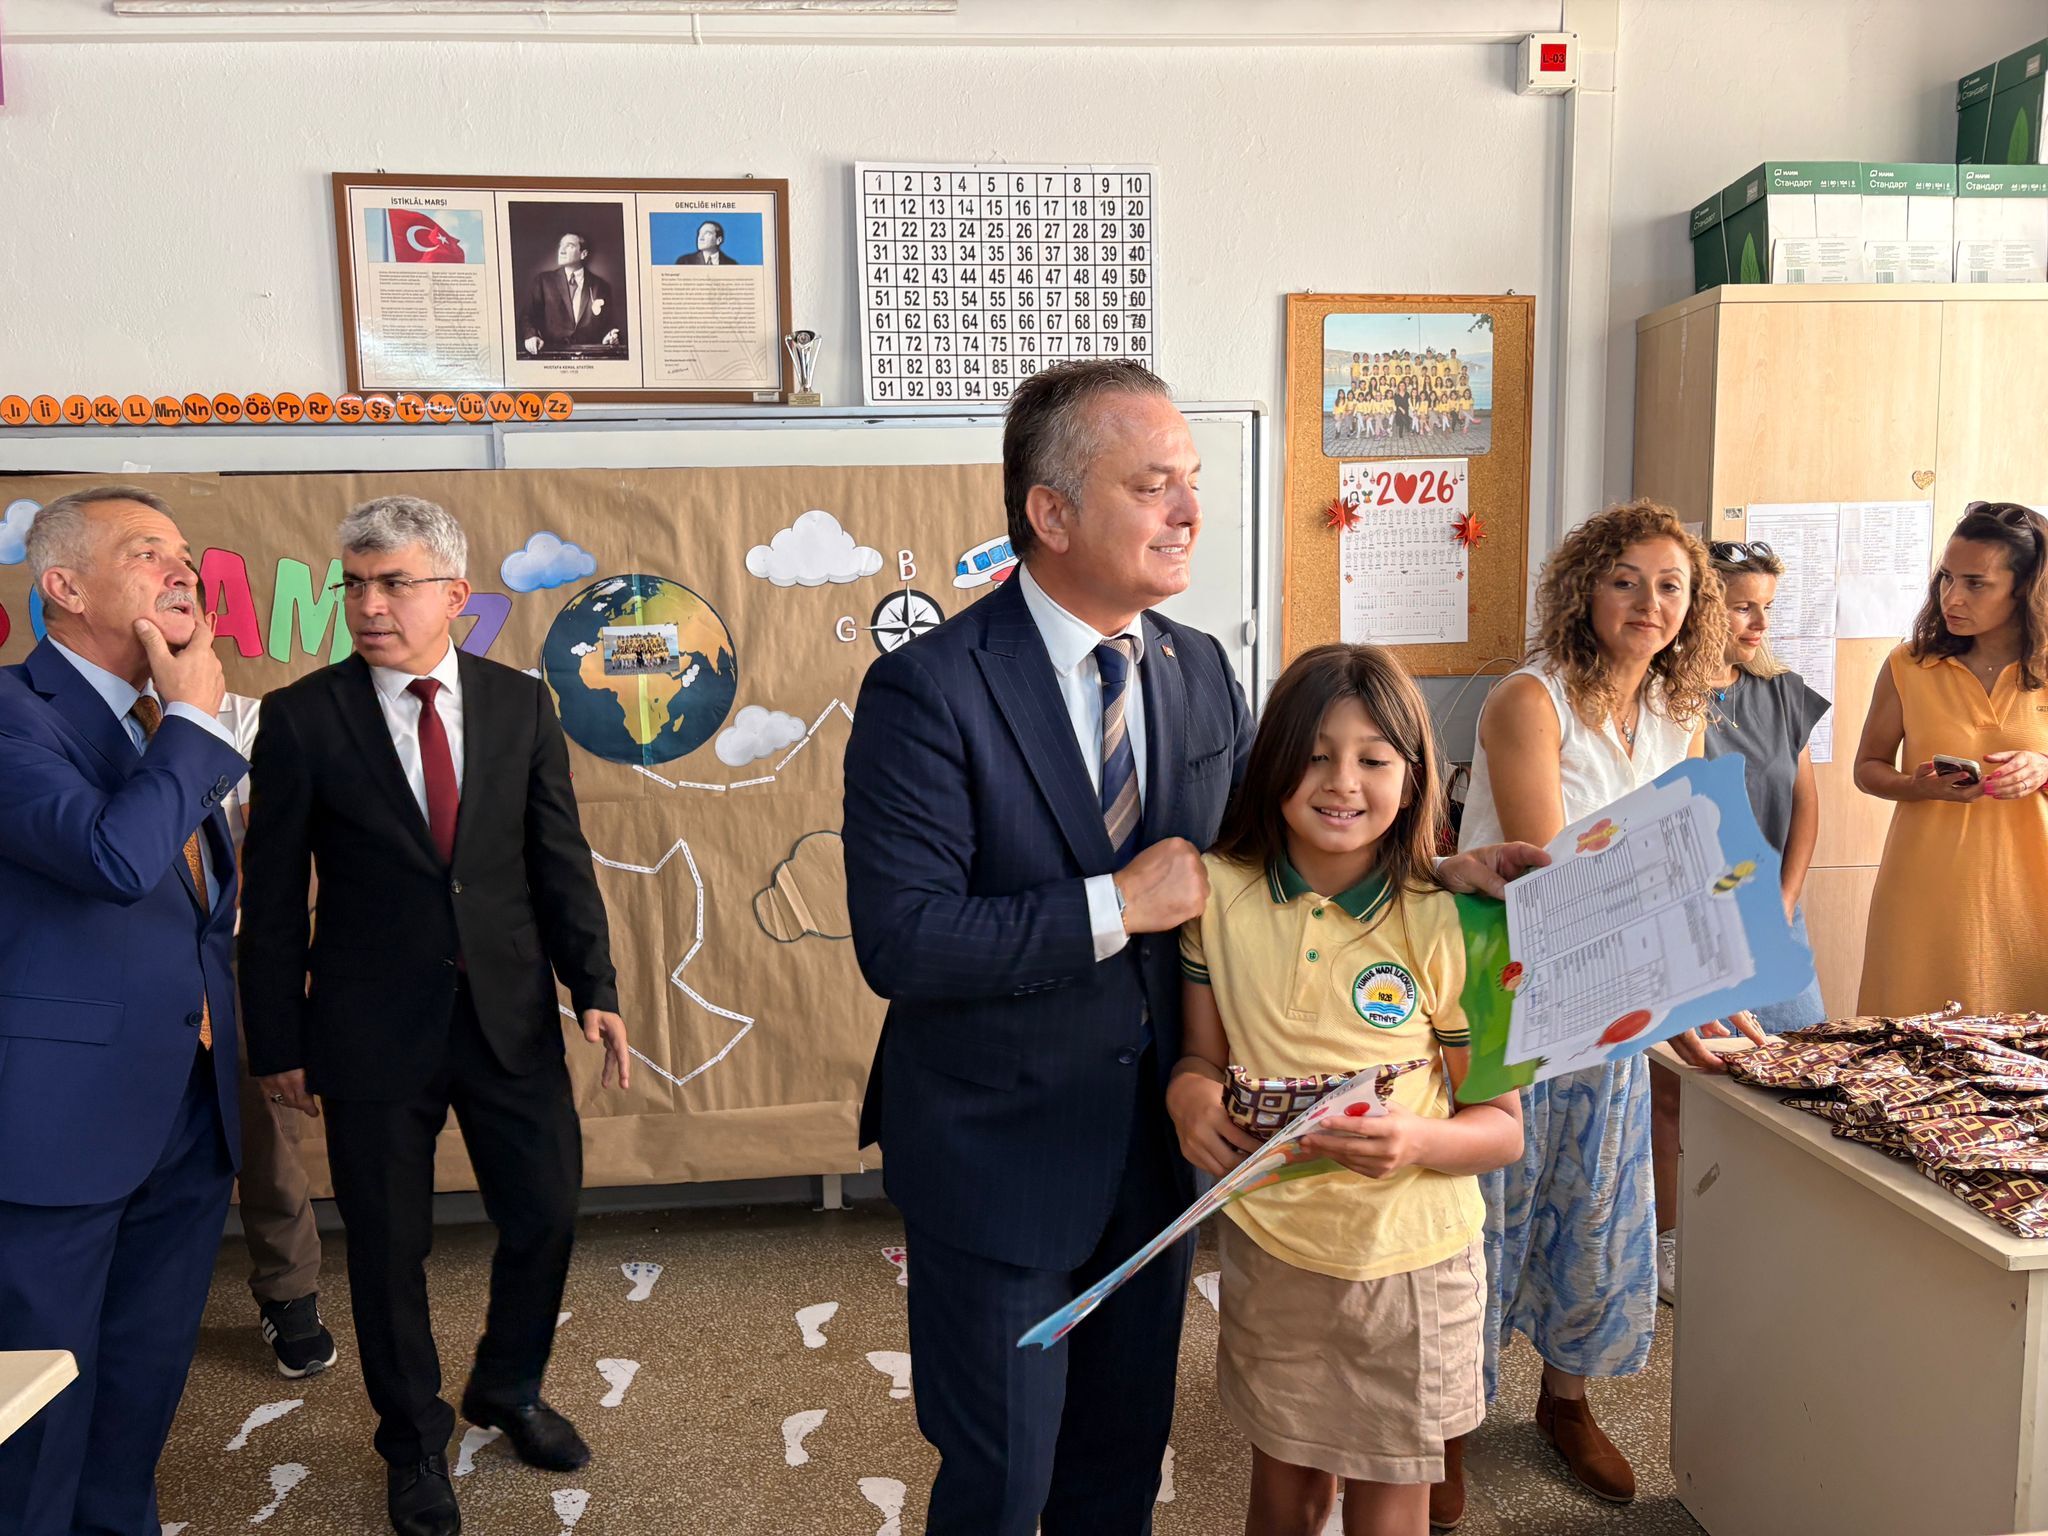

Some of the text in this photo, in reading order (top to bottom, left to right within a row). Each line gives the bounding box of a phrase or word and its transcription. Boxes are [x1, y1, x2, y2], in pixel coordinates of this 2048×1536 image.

[875, 174, 1142, 193] 1 2 3 4 5 6 7 8 9 10
[1774, 178, 1812, 188] Стандарт
[1870, 180, 1908, 189] Стандарт
[1966, 182, 2004, 191] Стандарт
[872, 198, 1144, 216] 11 12 13 14 15 16 17 18 19 20
[872, 221, 1145, 239] 21 22 23 24 25 26 27 28 29 30
[873, 244, 1145, 262] 31 32 33 34 35 36 37 38 39 40
[874, 267, 1145, 284] 41 42 43 44 45 46 47 48 49 50
[875, 290, 1145, 307] 51 52 53 54 55 56 57 58 59 60
[876, 313, 1146, 330] 61 62 63 64 65 66 67 68 69 70
[876, 336, 1146, 352] 71 72 73 74 75 76 77 78 79 80
[878, 358, 892, 374] 81
[907, 358, 923, 374] 82
[936, 358, 951, 374] 83
[964, 358, 980, 374] 84
[992, 358, 1008, 374] 85
[1020, 359, 1036, 374] 86
[879, 381, 1009, 397] 91 92 93 94 95
[70, 403, 84, 419] Jj
[96, 404, 118, 417] Kk
[130, 403, 145, 416] Ll
[155, 404, 181, 417] Mm
[185, 402, 209, 416] Nn
[216, 402, 240, 415] Oo
[247, 398, 271, 415] Öö
[278, 402, 300, 418] Pp
[310, 402, 328, 414] Rr
[341, 402, 359, 415] Ss
[372, 402, 390, 419] Şş
[401, 403, 420, 415] Tt
[460, 398, 483, 414] Üü
[490, 401, 510, 413] Vv
[520, 400, 540, 416] Yy
[549, 400, 566, 412] Zz
[898, 550, 917, 581] B
[835, 616, 857, 642] G
[1356, 970, 1375, 990] YUNUS
[1370, 1013, 1397, 1024] FETHİYE
